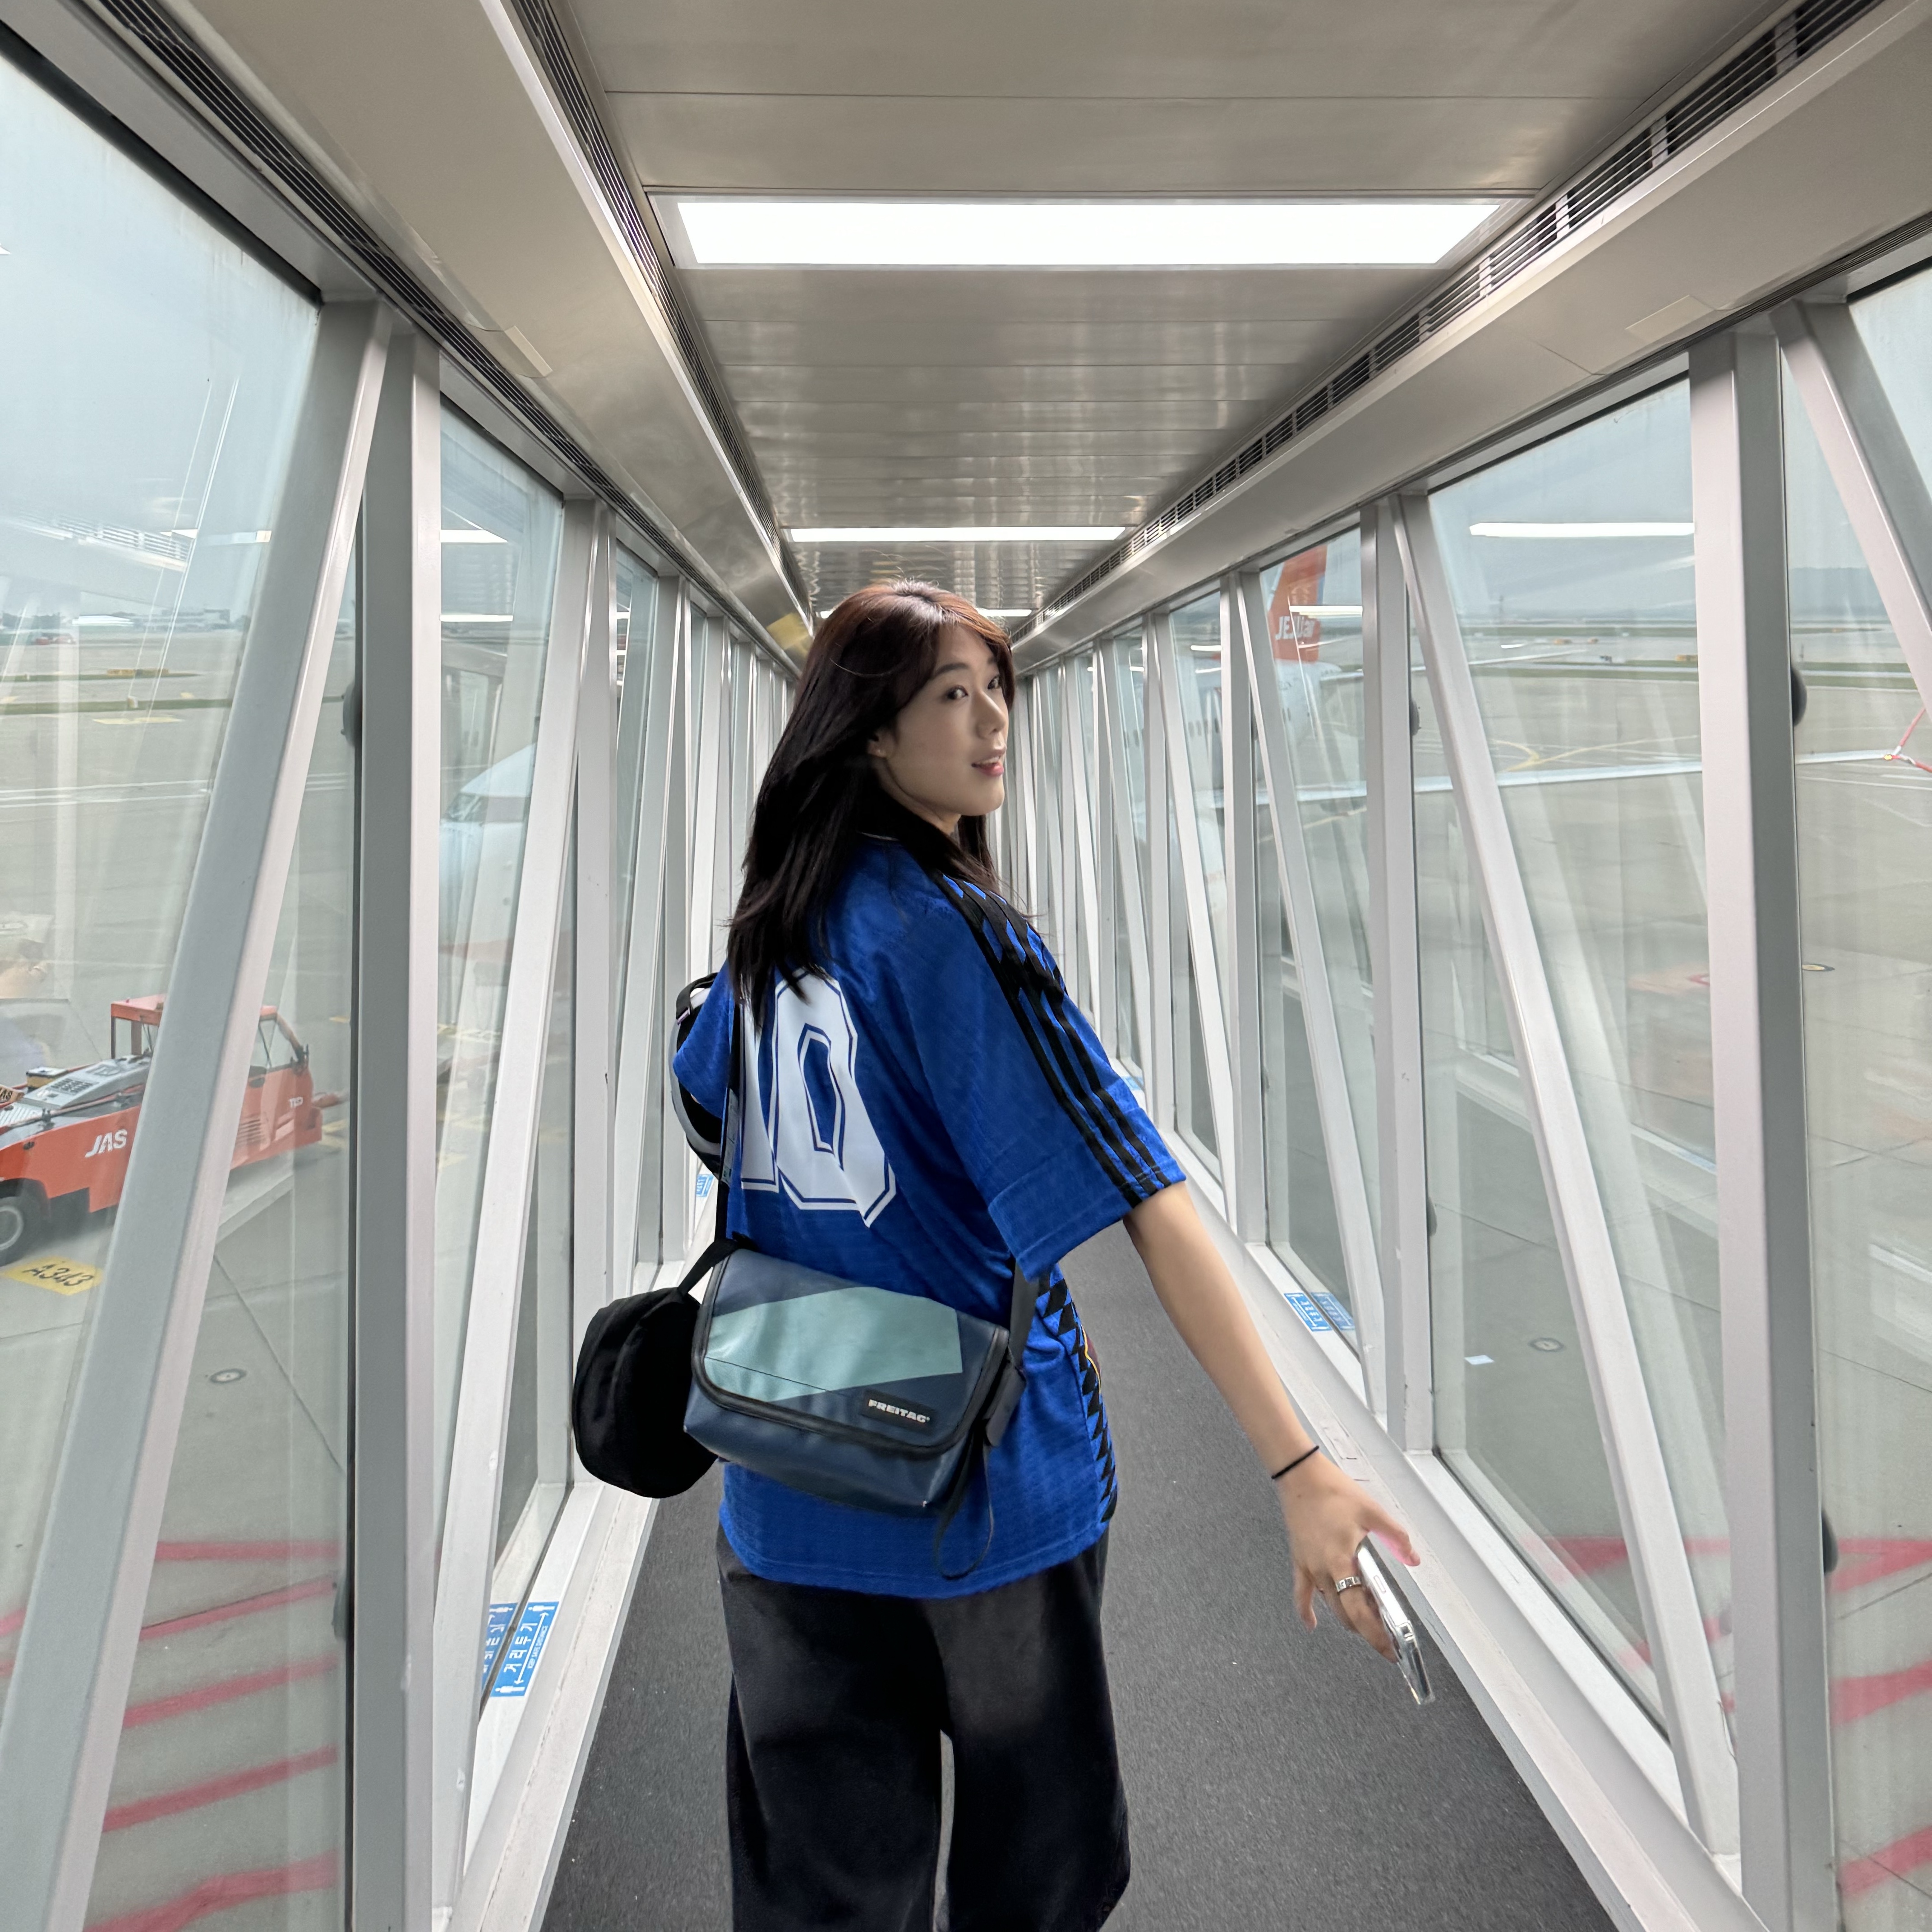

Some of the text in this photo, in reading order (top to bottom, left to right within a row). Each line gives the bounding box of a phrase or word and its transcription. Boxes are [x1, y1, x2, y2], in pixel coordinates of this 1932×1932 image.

[84, 1129, 128, 1158] JAS
[868, 1399, 927, 1423] FREITAG
[503, 1623, 538, 1673] 거리두기
